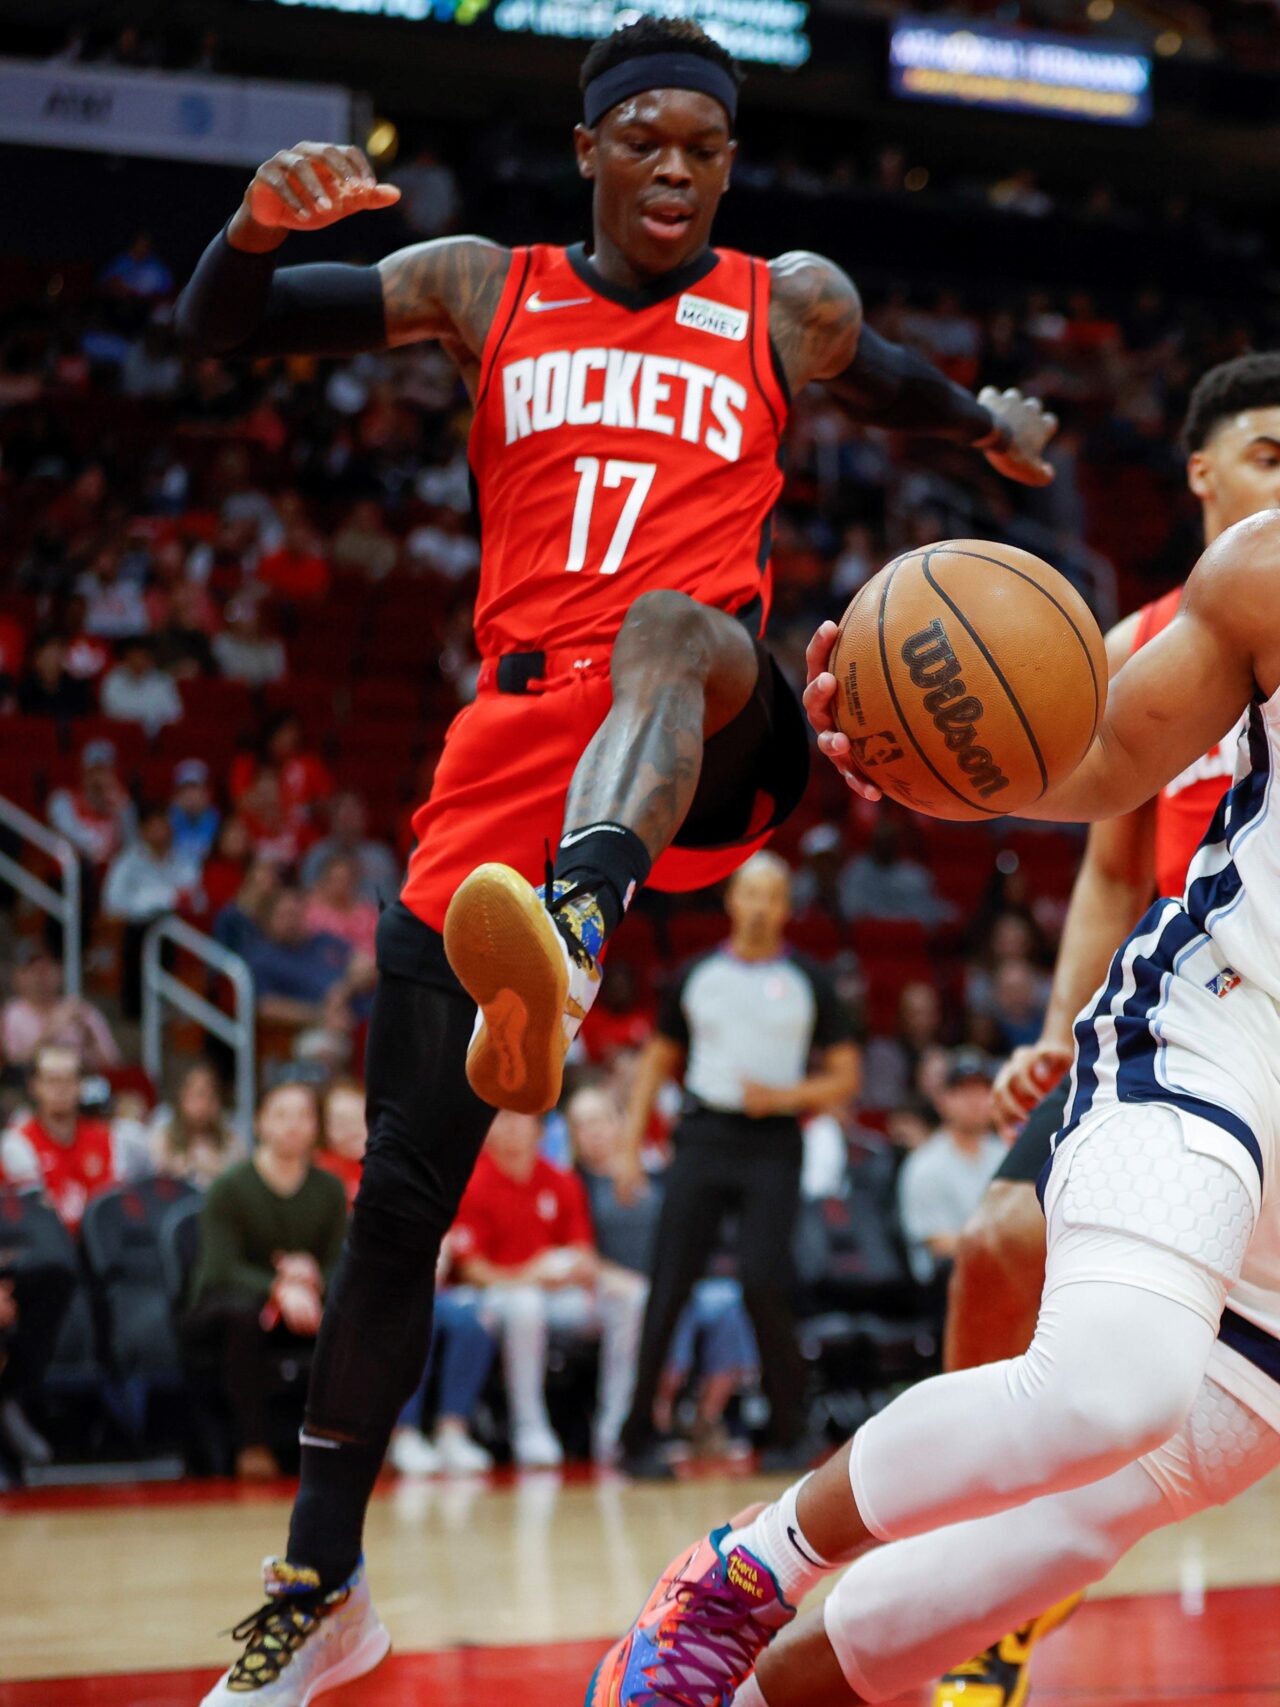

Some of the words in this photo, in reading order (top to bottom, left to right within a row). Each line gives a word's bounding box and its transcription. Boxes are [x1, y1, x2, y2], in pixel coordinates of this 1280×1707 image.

[681, 310, 740, 337] MONEY
[503, 347, 746, 462] ROCKETS
[565, 457, 656, 574] 17
[901, 617, 1009, 798] Wilson
